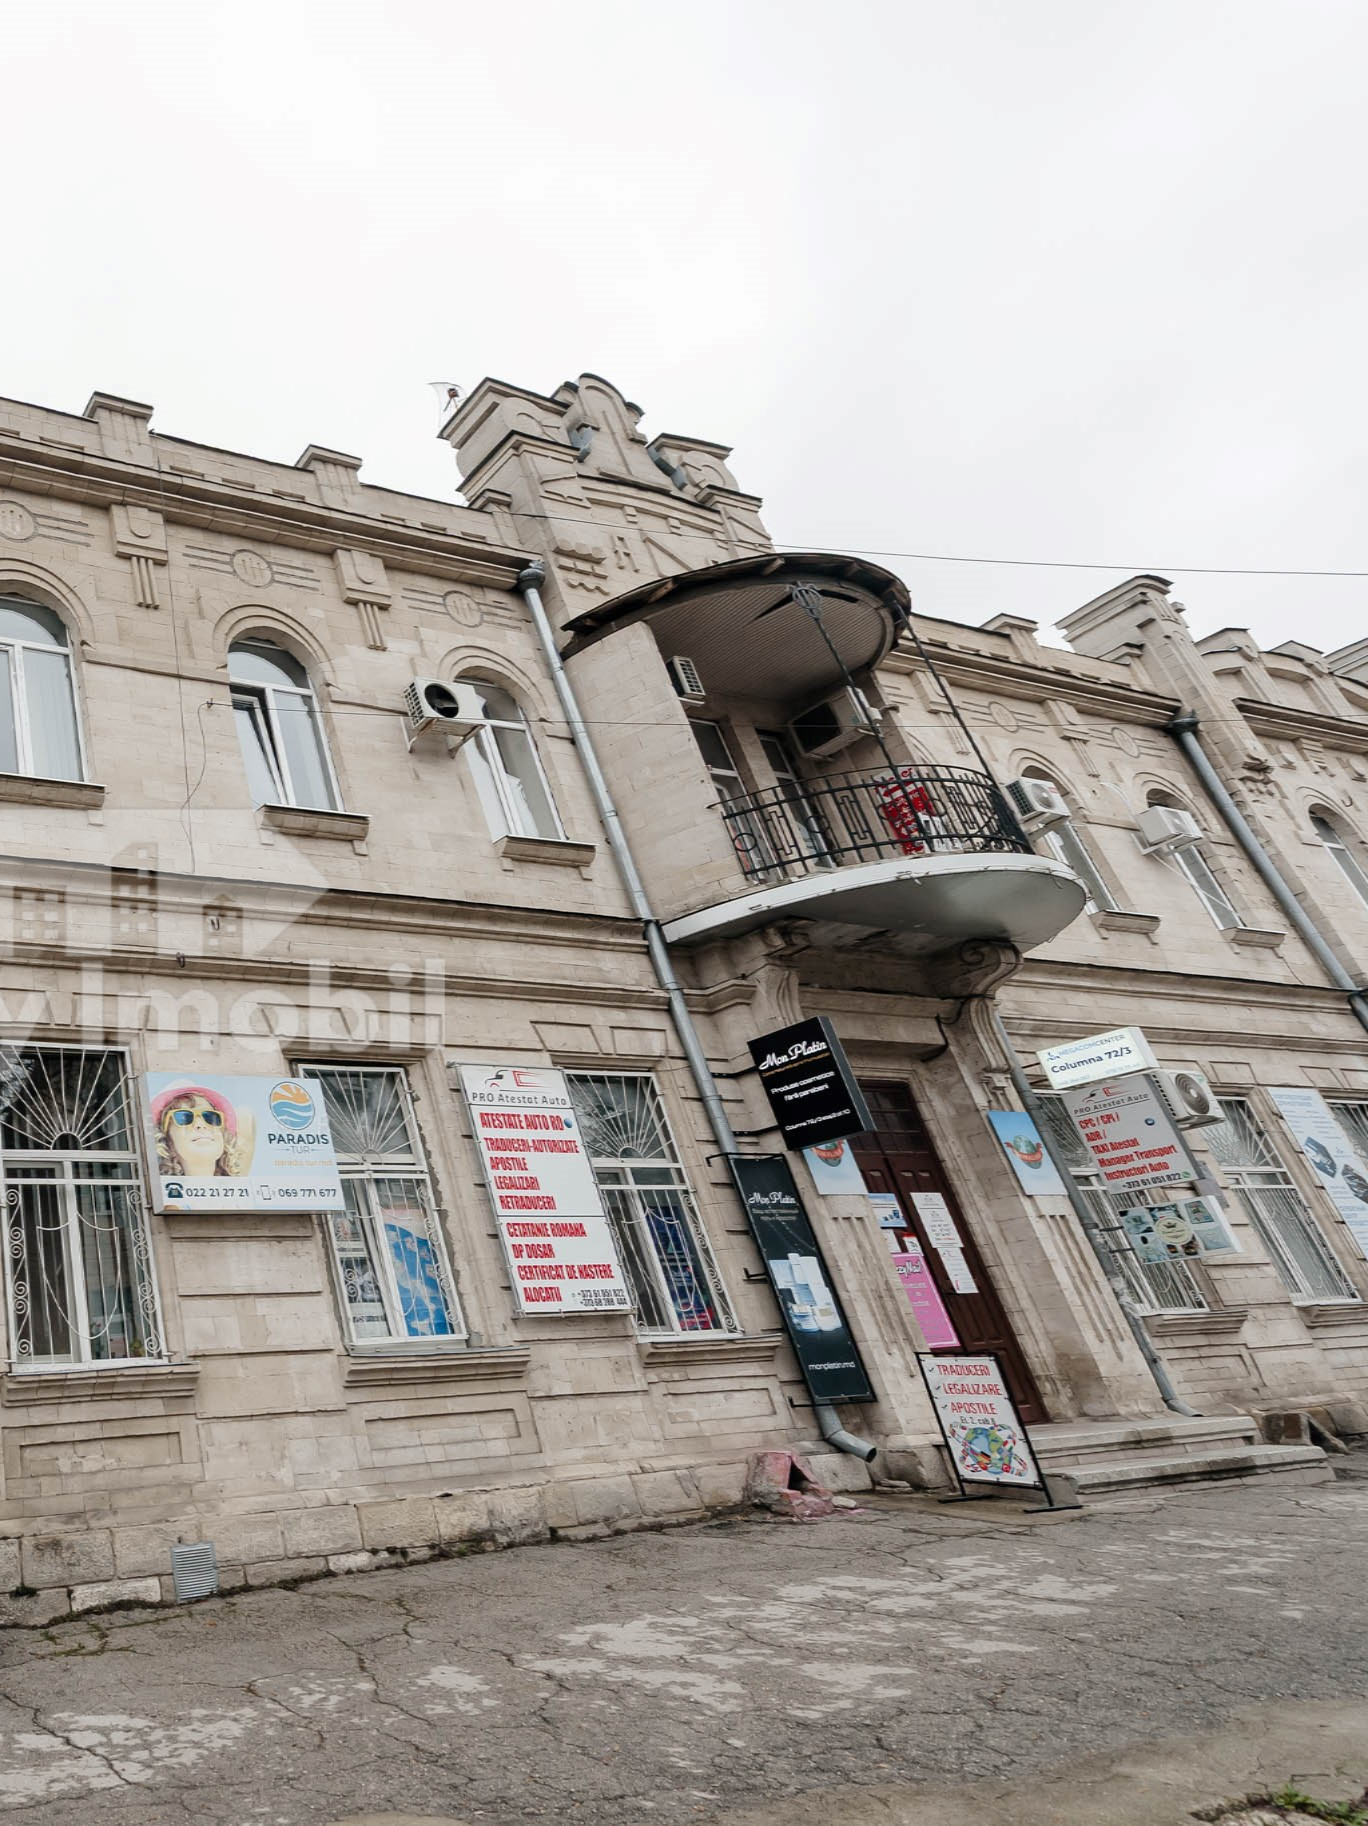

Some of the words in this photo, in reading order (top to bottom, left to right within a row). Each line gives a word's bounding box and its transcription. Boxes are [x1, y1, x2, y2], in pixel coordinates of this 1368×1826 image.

[758, 1052, 789, 1070] Mon
[788, 1040, 828, 1060] Platin
[1050, 1055, 1104, 1073] Columna
[1104, 1046, 1132, 1060] 72/3
[472, 1092, 494, 1103] PRO
[497, 1093, 538, 1105] Atestat
[541, 1095, 567, 1106] Auto
[1073, 1106, 1091, 1115] PRO
[1093, 1098, 1125, 1111] Atestat
[1126, 1093, 1149, 1103] Auto
[479, 1112, 524, 1130] ATESTATE
[523, 1114, 550, 1131] AUTO
[548, 1115, 565, 1131] RO
[267, 1133, 330, 1145] PARADIS
[483, 1137, 580, 1154] TRADUCERI-AUTORIZATE
[1091, 1143, 1110, 1155] TAXI
[1109, 1137, 1141, 1152] Atestat
[290, 1145, 311, 1154] TUR
[1097, 1153, 1135, 1168] Manager
[1133, 1144, 1179, 1161] Transport
[489, 1156, 529, 1171] APOSTILE
[1104, 1164, 1150, 1182] Instructori
[1148, 1161, 1170, 1173] Auto
[494, 1175, 541, 1191] LEGALIZARI
[1141, 1179, 1151, 1188] 61
[185, 1188, 207, 1198] 022
[209, 1188, 220, 1198] 21
[223, 1188, 234, 1198] 27
[238, 1188, 249, 1198] 21
[278, 1188, 298, 1198] 069
[301, 1188, 317, 1198] 771
[319, 1188, 337, 1198] 677
[748, 1191, 770, 1204] Mon
[769, 1191, 797, 1204] Platin
[498, 1194, 558, 1211] RETRADUCERI
[506, 1222, 551, 1238] CETATANIE
[549, 1222, 588, 1238] ROMANA
[524, 1243, 556, 1259] DOSAR
[517, 1264, 566, 1281] CERTIFICAT
[565, 1264, 579, 1280] DE
[576, 1263, 615, 1279] NASTERE
[808, 1361, 856, 1371] monplatin.md
[936, 1364, 991, 1377] TRADUCERI
[942, 1382, 1003, 1396] LEGALIZARE
[950, 1402, 998, 1415] APOSTILE
